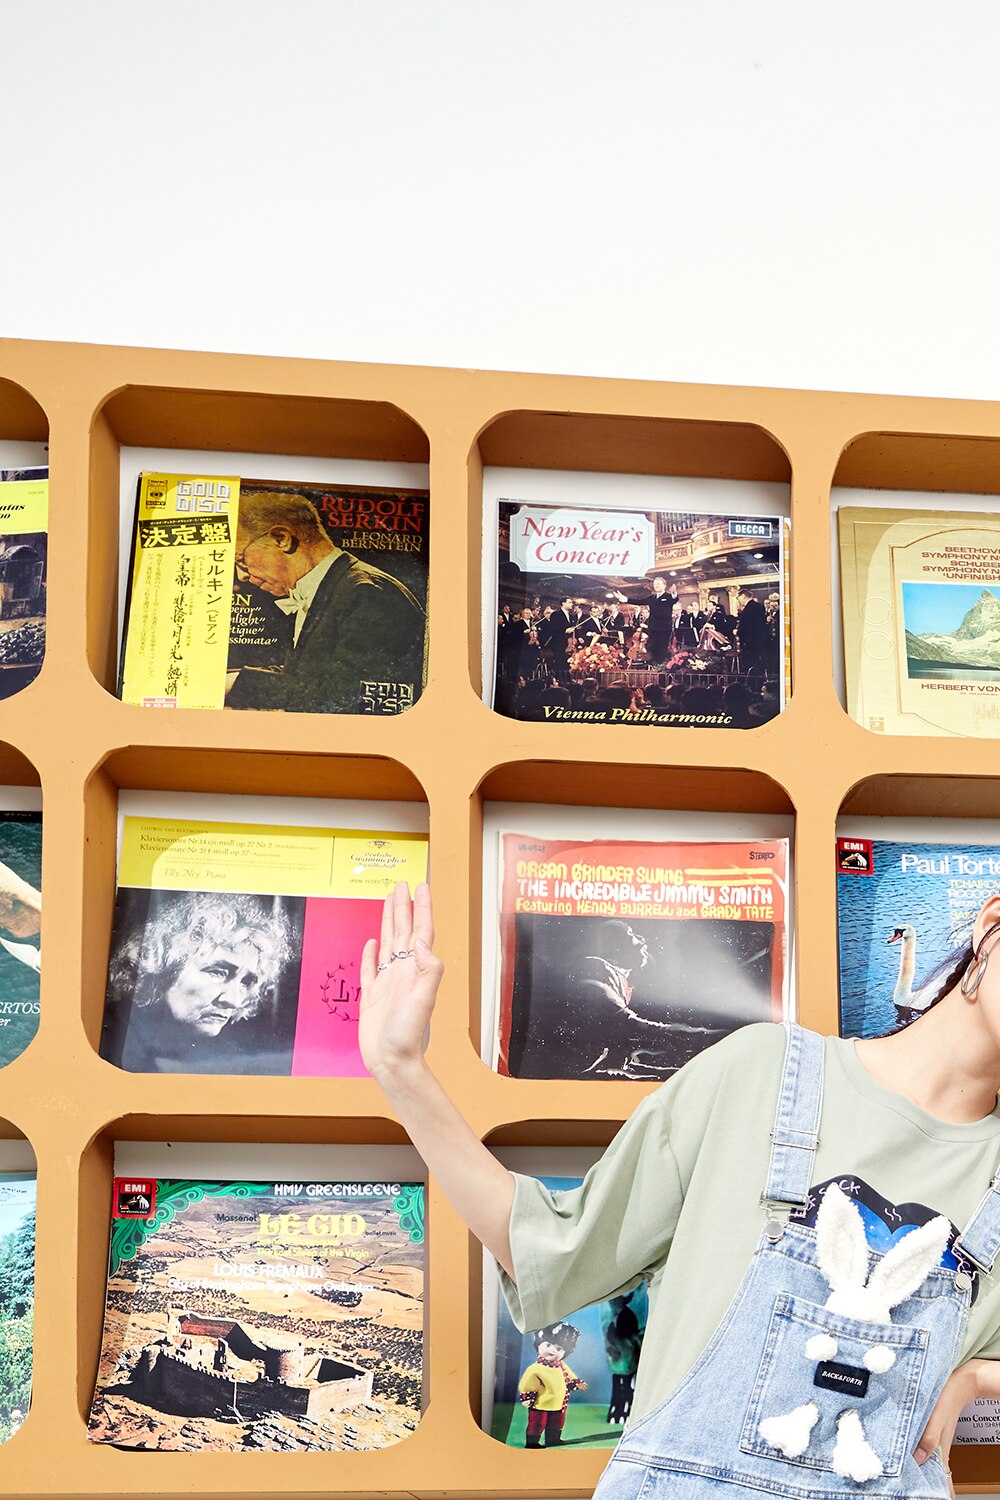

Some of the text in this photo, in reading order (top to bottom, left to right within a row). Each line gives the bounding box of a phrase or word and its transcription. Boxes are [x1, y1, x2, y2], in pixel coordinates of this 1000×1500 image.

[177, 481, 230, 498] GOLD
[176, 498, 230, 513] DISC
[320, 496, 425, 517] RUDOLF
[327, 511, 422, 533] SERKIN
[735, 524, 765, 534] DECCA
[141, 523, 229, 548] 決定盤
[522, 517, 644, 543] New Year's
[353, 531, 423, 545] LEONARD
[341, 539, 421, 553] BERNSTEIN
[535, 541, 630, 566] Concert
[921, 551, 987, 561] SYMPHONY
[922, 565, 987, 574] SYMPHONY
[921, 683, 976, 691] HERBERT
[543, 705, 733, 725] Vienna Philharmonic
[140, 834, 187, 845] Klaviersonate
[844, 842, 864, 850] EMI
[140, 844, 185, 853] Klaviersonate
[749, 851, 776, 861] STEREO
[901, 853, 949, 875] Paul
[164, 868, 180, 878] Elly
[204, 870, 227, 879] Piano
[516, 860, 684, 886] ORGAN GRINDER SWING
[517, 879, 773, 906] THE INCREDIBLE JIMMY SMITH
[515, 897, 774, 920] Featuring KENNY BURRELL and GRADY TATE
[124, 1184, 146, 1192] EMI
[274, 1184, 401, 1196] HMV GREENSLEEVE
[216, 1213, 257, 1222] Massenet
[258, 1213, 301, 1235] LE
[293, 1249, 317, 1259] Sleep
[319, 1249, 331, 1257] of
[331, 1249, 343, 1257] the
[345, 1249, 370, 1260] Virgin
[214, 1264, 255, 1277] LOUIS
[324, 1281, 375, 1291] Orchestra
[821, 1370, 863, 1386] BACK&FORTH
